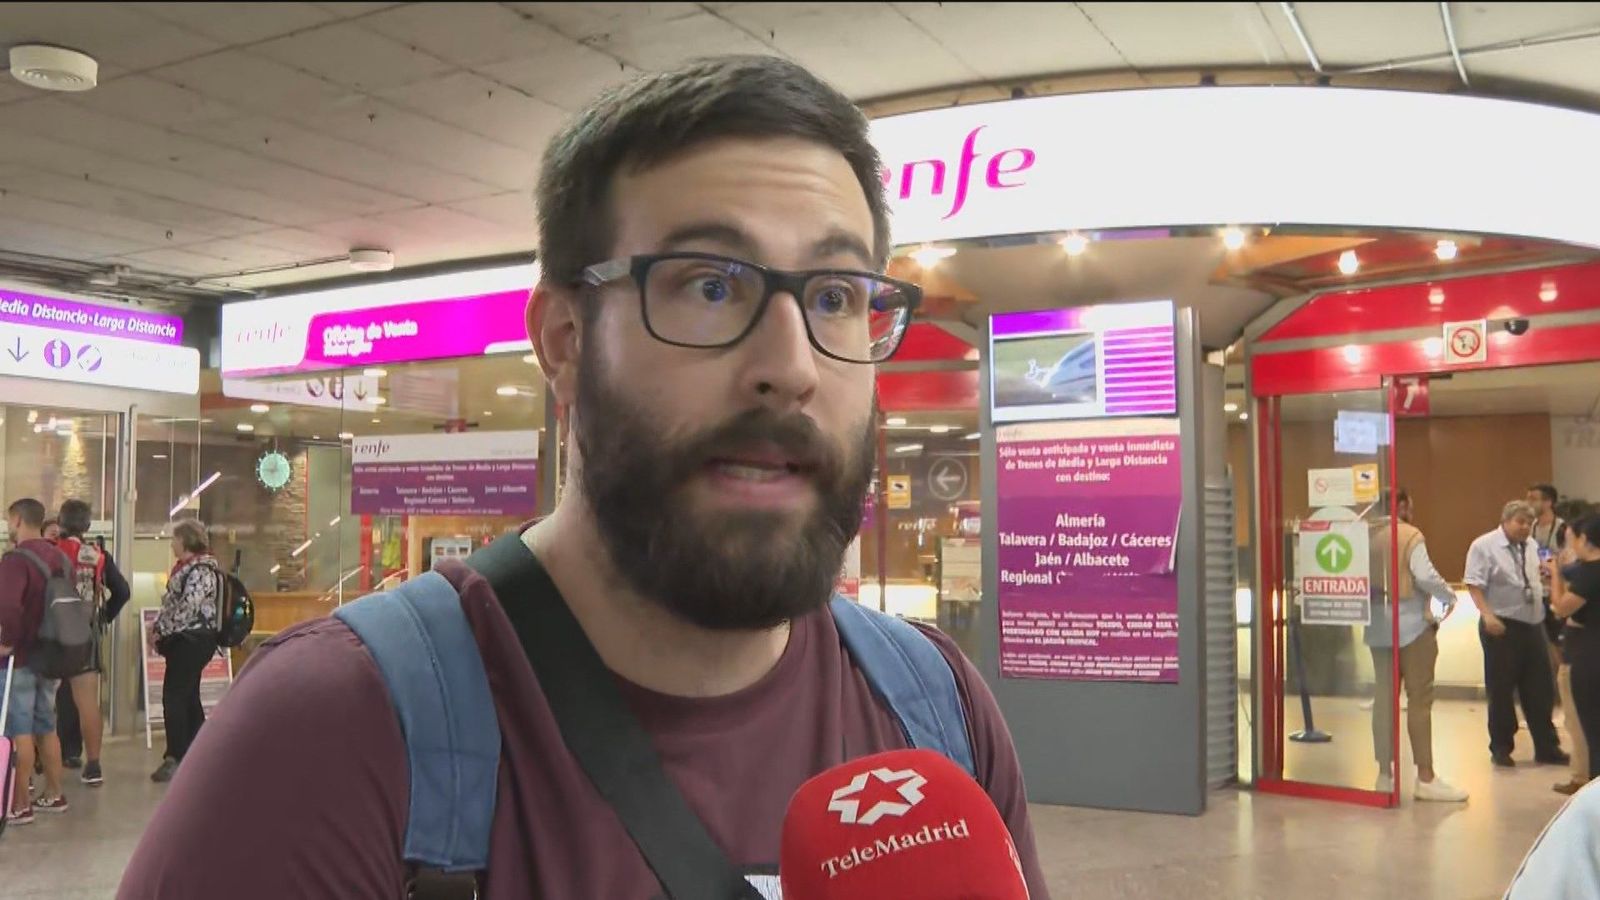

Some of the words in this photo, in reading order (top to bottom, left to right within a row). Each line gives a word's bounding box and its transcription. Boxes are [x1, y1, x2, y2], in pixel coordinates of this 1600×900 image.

[881, 125, 1036, 220] nfe
[0, 297, 29, 316] edia
[127, 316, 177, 338] Distancia
[367, 322, 382, 339] de
[354, 439, 390, 457] renfe
[1090, 444, 1097, 456] y
[1098, 442, 1124, 453] venta
[1126, 439, 1175, 451] inmediata
[1005, 459, 1016, 470] de
[1045, 458, 1056, 469] de
[1087, 458, 1093, 469] y
[1095, 456, 1122, 469] Larga
[1123, 453, 1168, 465] Distancia
[1055, 473, 1072, 482] con
[1055, 512, 1106, 528] Almería
[999, 532, 1047, 547] Talavera
[1049, 533, 1055, 547] /
[1058, 533, 1109, 549] Badajoz
[1111, 533, 1117, 547] /
[1120, 532, 1172, 547] Cáceres
[1035, 552, 1062, 567] Jaén
[1072, 552, 1130, 566] Albacete
[1000, 570, 1053, 586] Regional
[1304, 579, 1366, 593] ENTRADA
[820, 818, 970, 879] TeleMadrid
